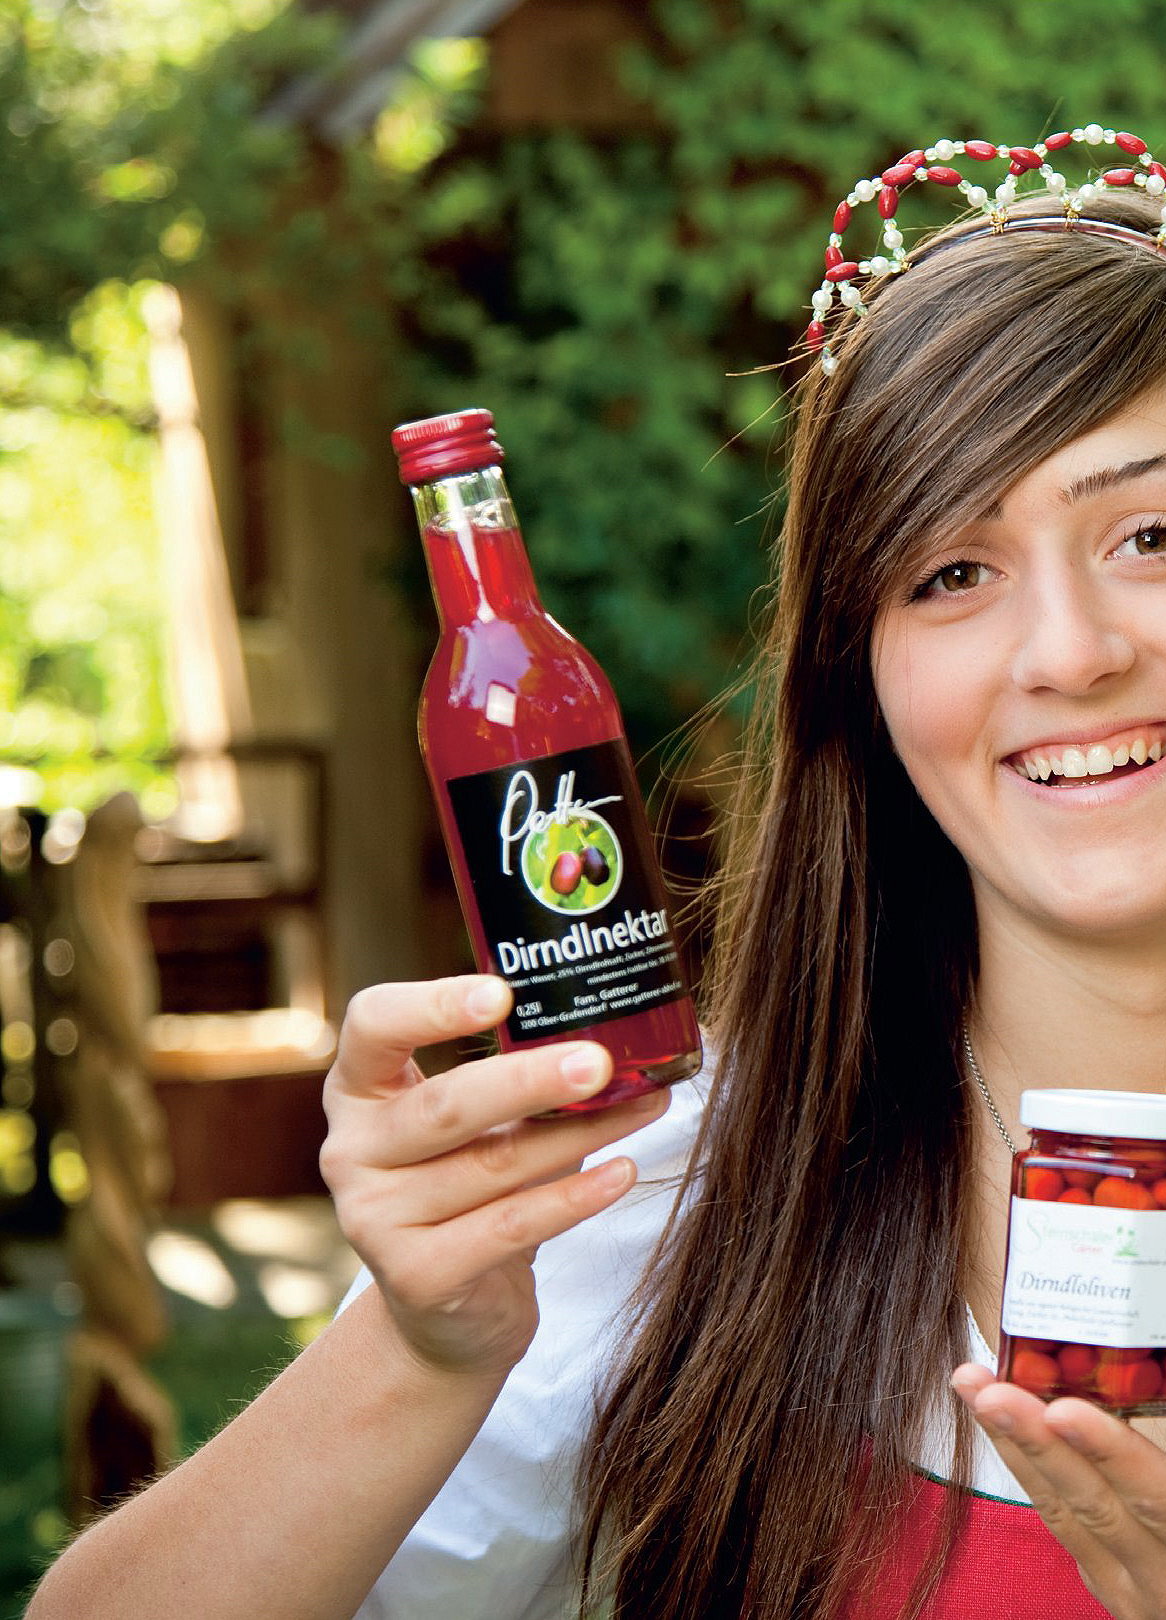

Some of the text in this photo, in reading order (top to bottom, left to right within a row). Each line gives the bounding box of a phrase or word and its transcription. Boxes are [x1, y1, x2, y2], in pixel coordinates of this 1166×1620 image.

[498, 909, 668, 975] Dirndlnektar
[573, 982, 639, 1007] Fam. Gatterer
[1019, 1270, 1132, 1301] Dirndloliven
